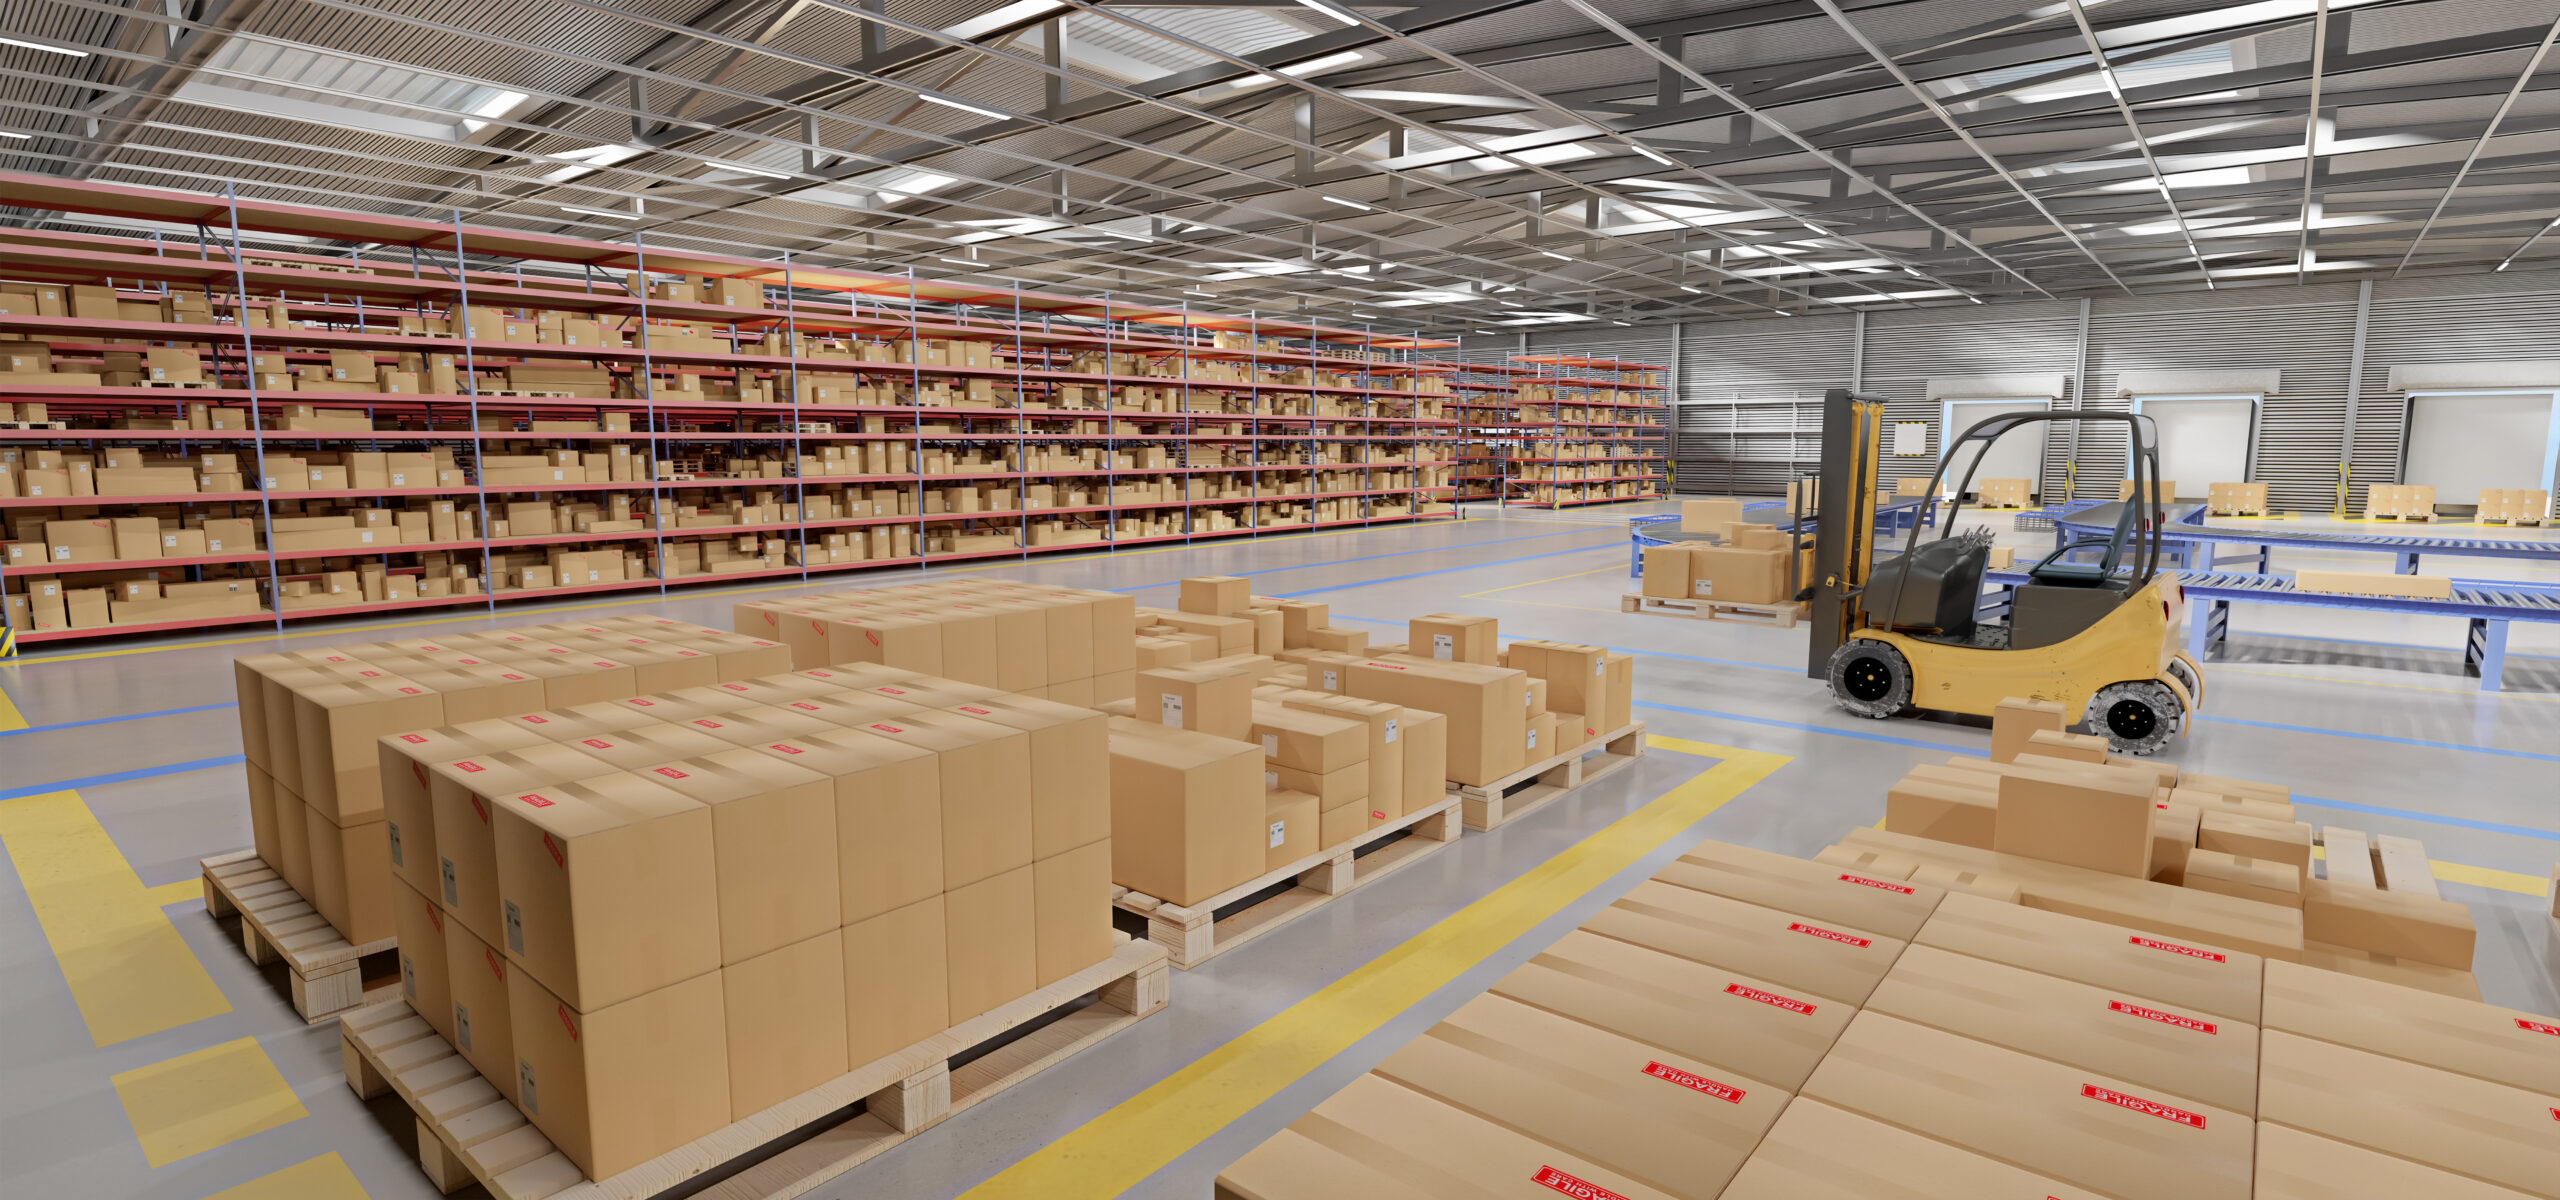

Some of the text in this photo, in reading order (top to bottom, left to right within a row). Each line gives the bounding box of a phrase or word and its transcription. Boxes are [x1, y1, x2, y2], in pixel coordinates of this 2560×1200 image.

[1848, 876, 1904, 893] FRAGILE
[1798, 926, 1860, 945] FRAGILE
[2140, 940, 2214, 960] FRAGILE
[1735, 988, 1805, 1011] FRAGILE
[2120, 1006, 2204, 1031] FRAGILE
[1653, 1068, 1732, 1098] FRAGILE
[2095, 1091, 2191, 1123] FRAGILE
[1544, 1175, 1607, 1200] AGILE
